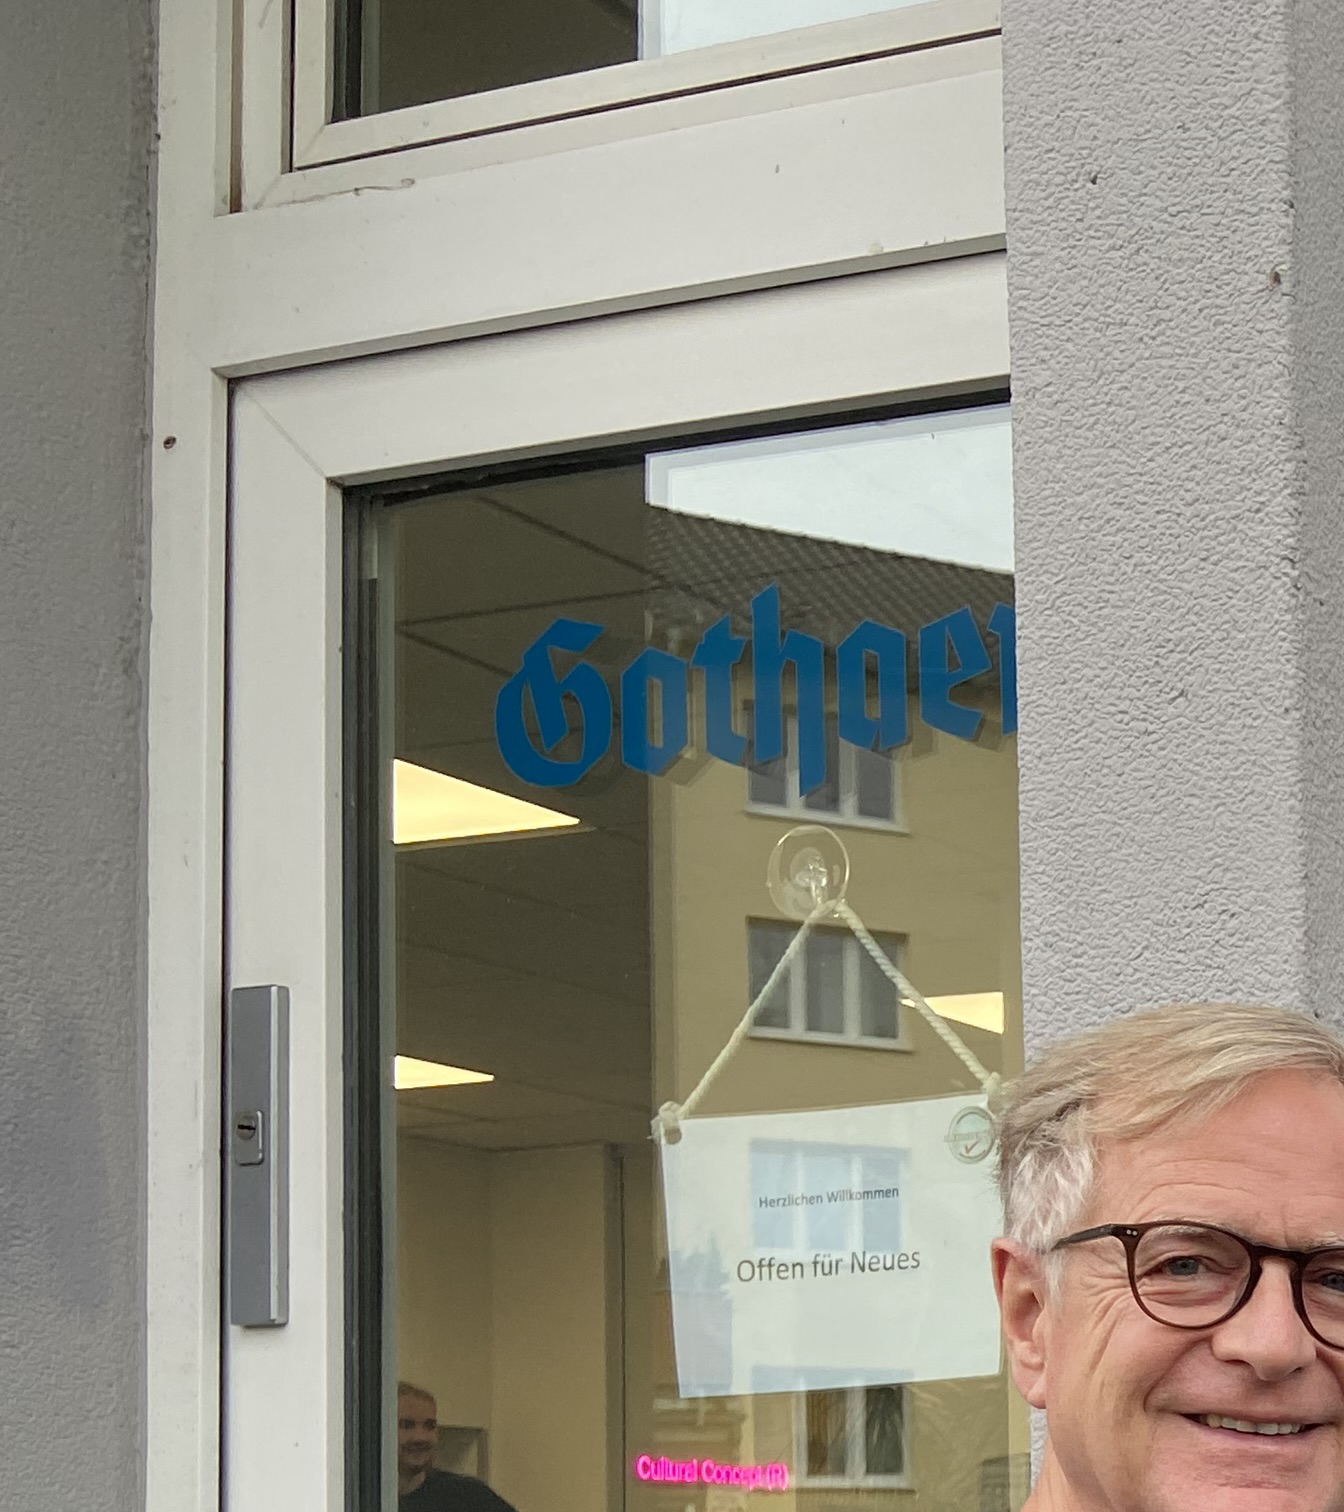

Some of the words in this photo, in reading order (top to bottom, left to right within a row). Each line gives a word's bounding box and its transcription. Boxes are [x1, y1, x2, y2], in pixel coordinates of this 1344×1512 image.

[759, 1194, 823, 1208] Herzlichen
[827, 1188, 899, 1203] Willkommen
[737, 1257, 804, 1282] Offen
[812, 1253, 842, 1278] für
[851, 1251, 920, 1273] Neues
[637, 1454, 698, 1482] Cultural
